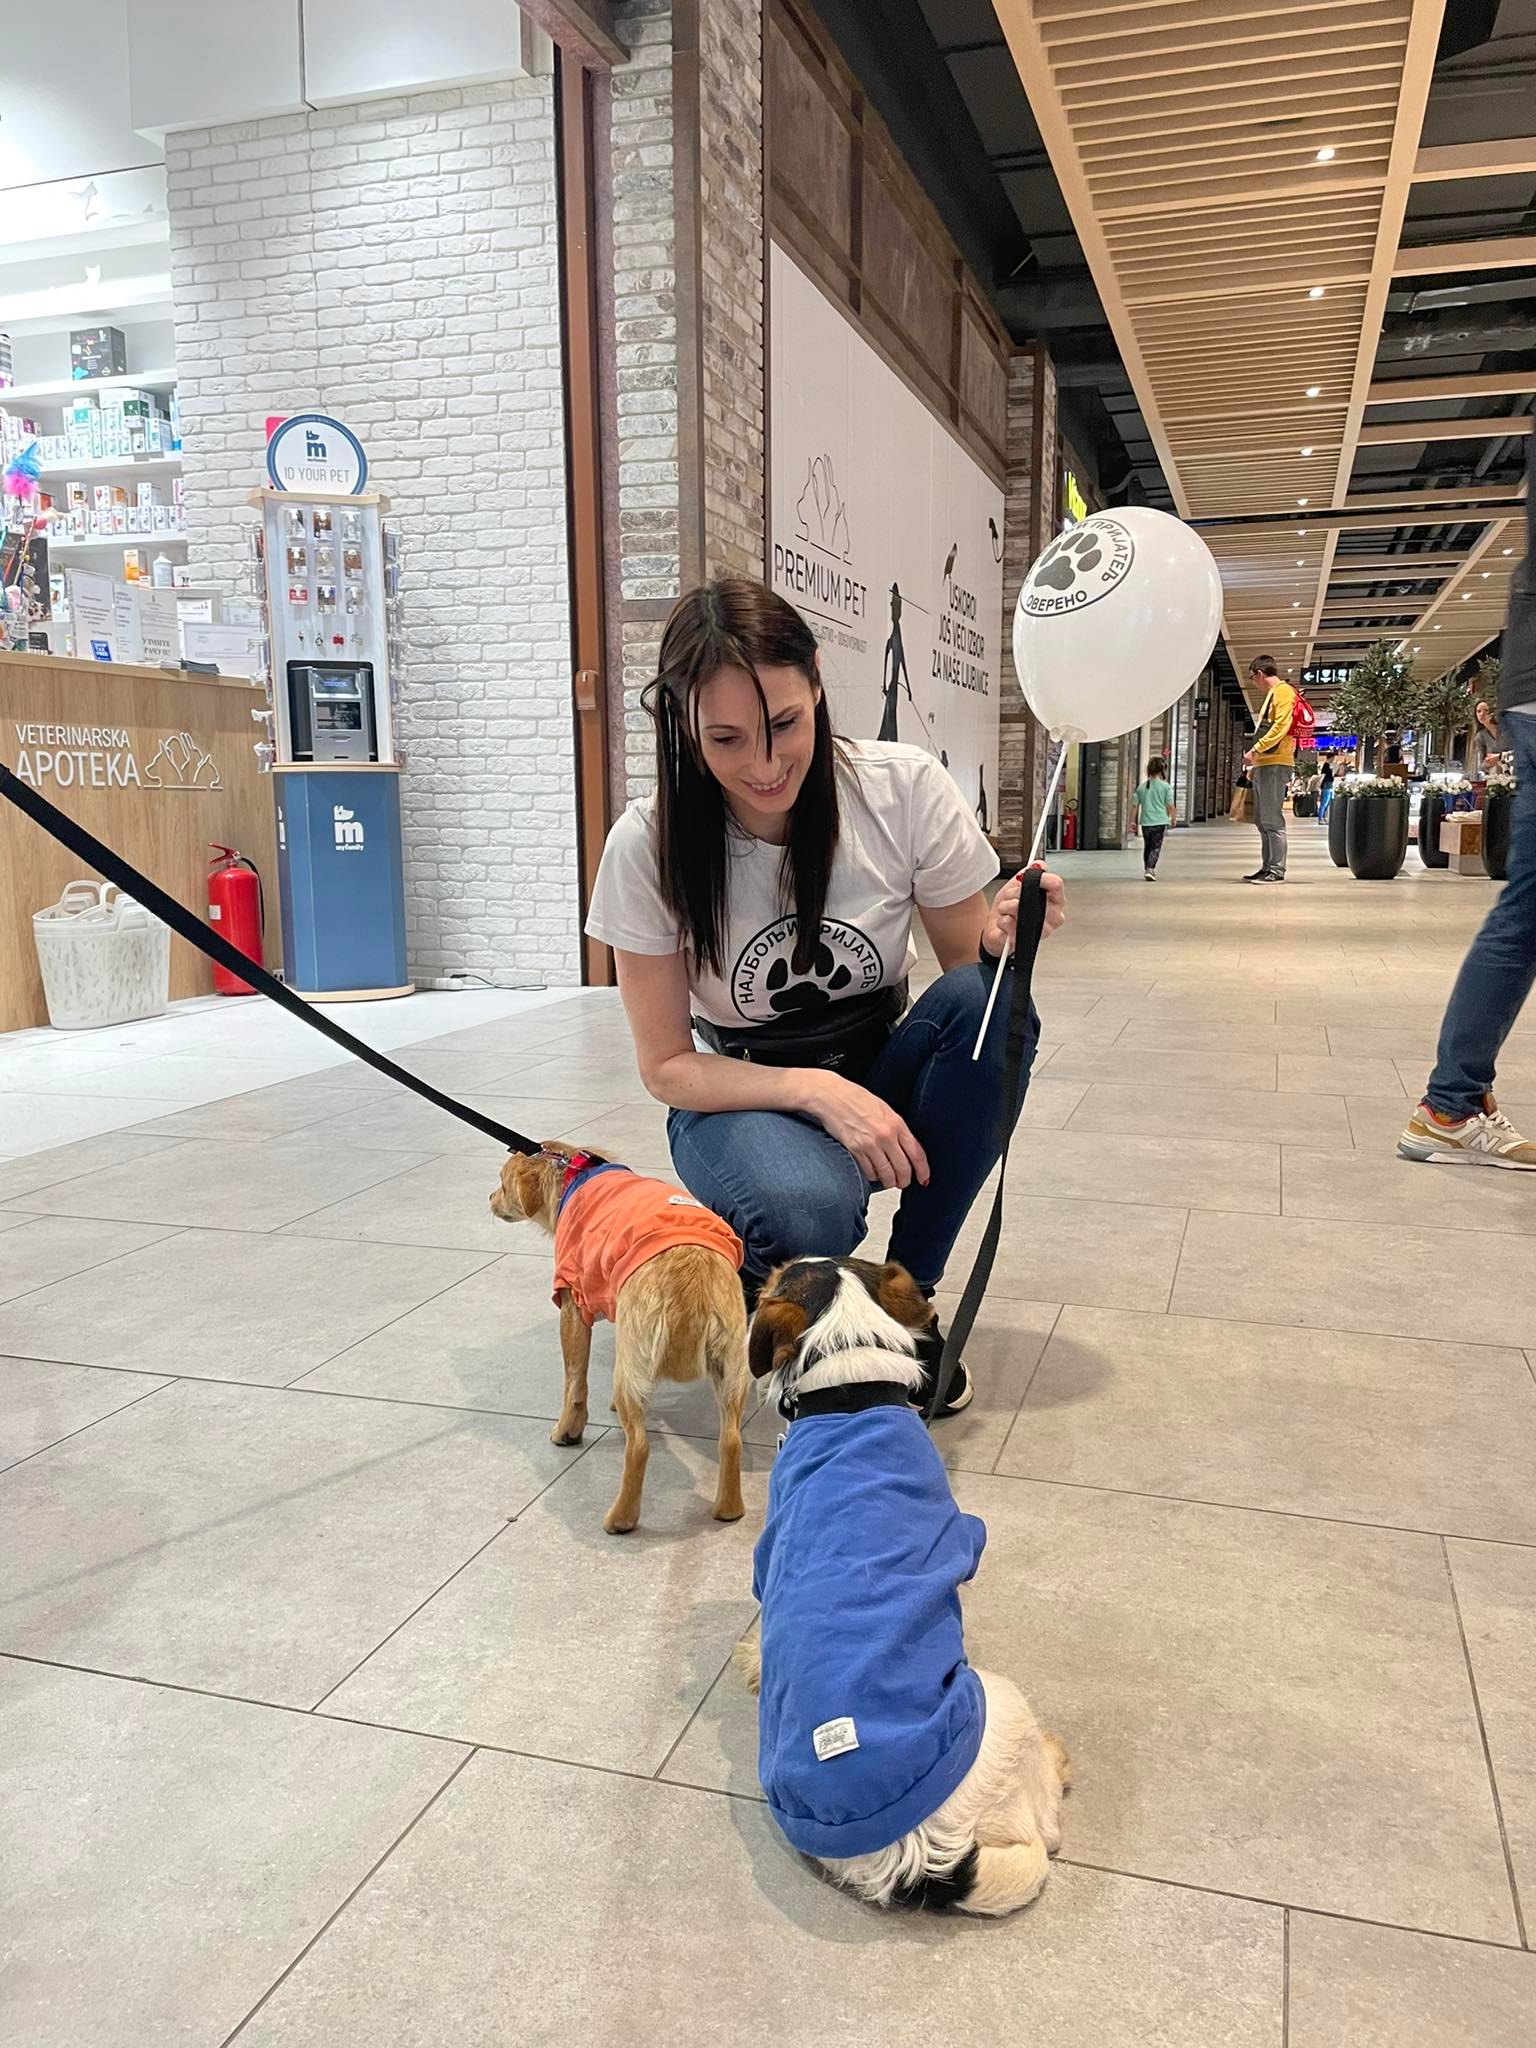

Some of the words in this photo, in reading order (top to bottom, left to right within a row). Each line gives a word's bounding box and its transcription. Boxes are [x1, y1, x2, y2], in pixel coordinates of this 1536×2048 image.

[283, 466, 295, 481] ID
[298, 467, 327, 482] YOUR
[330, 469, 350, 484] PET
[1091, 520, 1129, 582] ПРИЈАТЕЉ
[774, 543, 841, 608] PREMIUM
[844, 577, 867, 618] PET
[1026, 590, 1088, 612] ОВЕРЕНО
[939, 610, 951, 645] JOŠ
[932, 648, 942, 679] ZA
[943, 651, 960, 687] NAŠE
[15, 723, 131, 748] VETERINARSKA
[16, 750, 141, 787] APOTEKA
[738, 920, 800, 1004] НАЈБОЉИ
[818, 923, 879, 990] РИЈАТЕЉ
